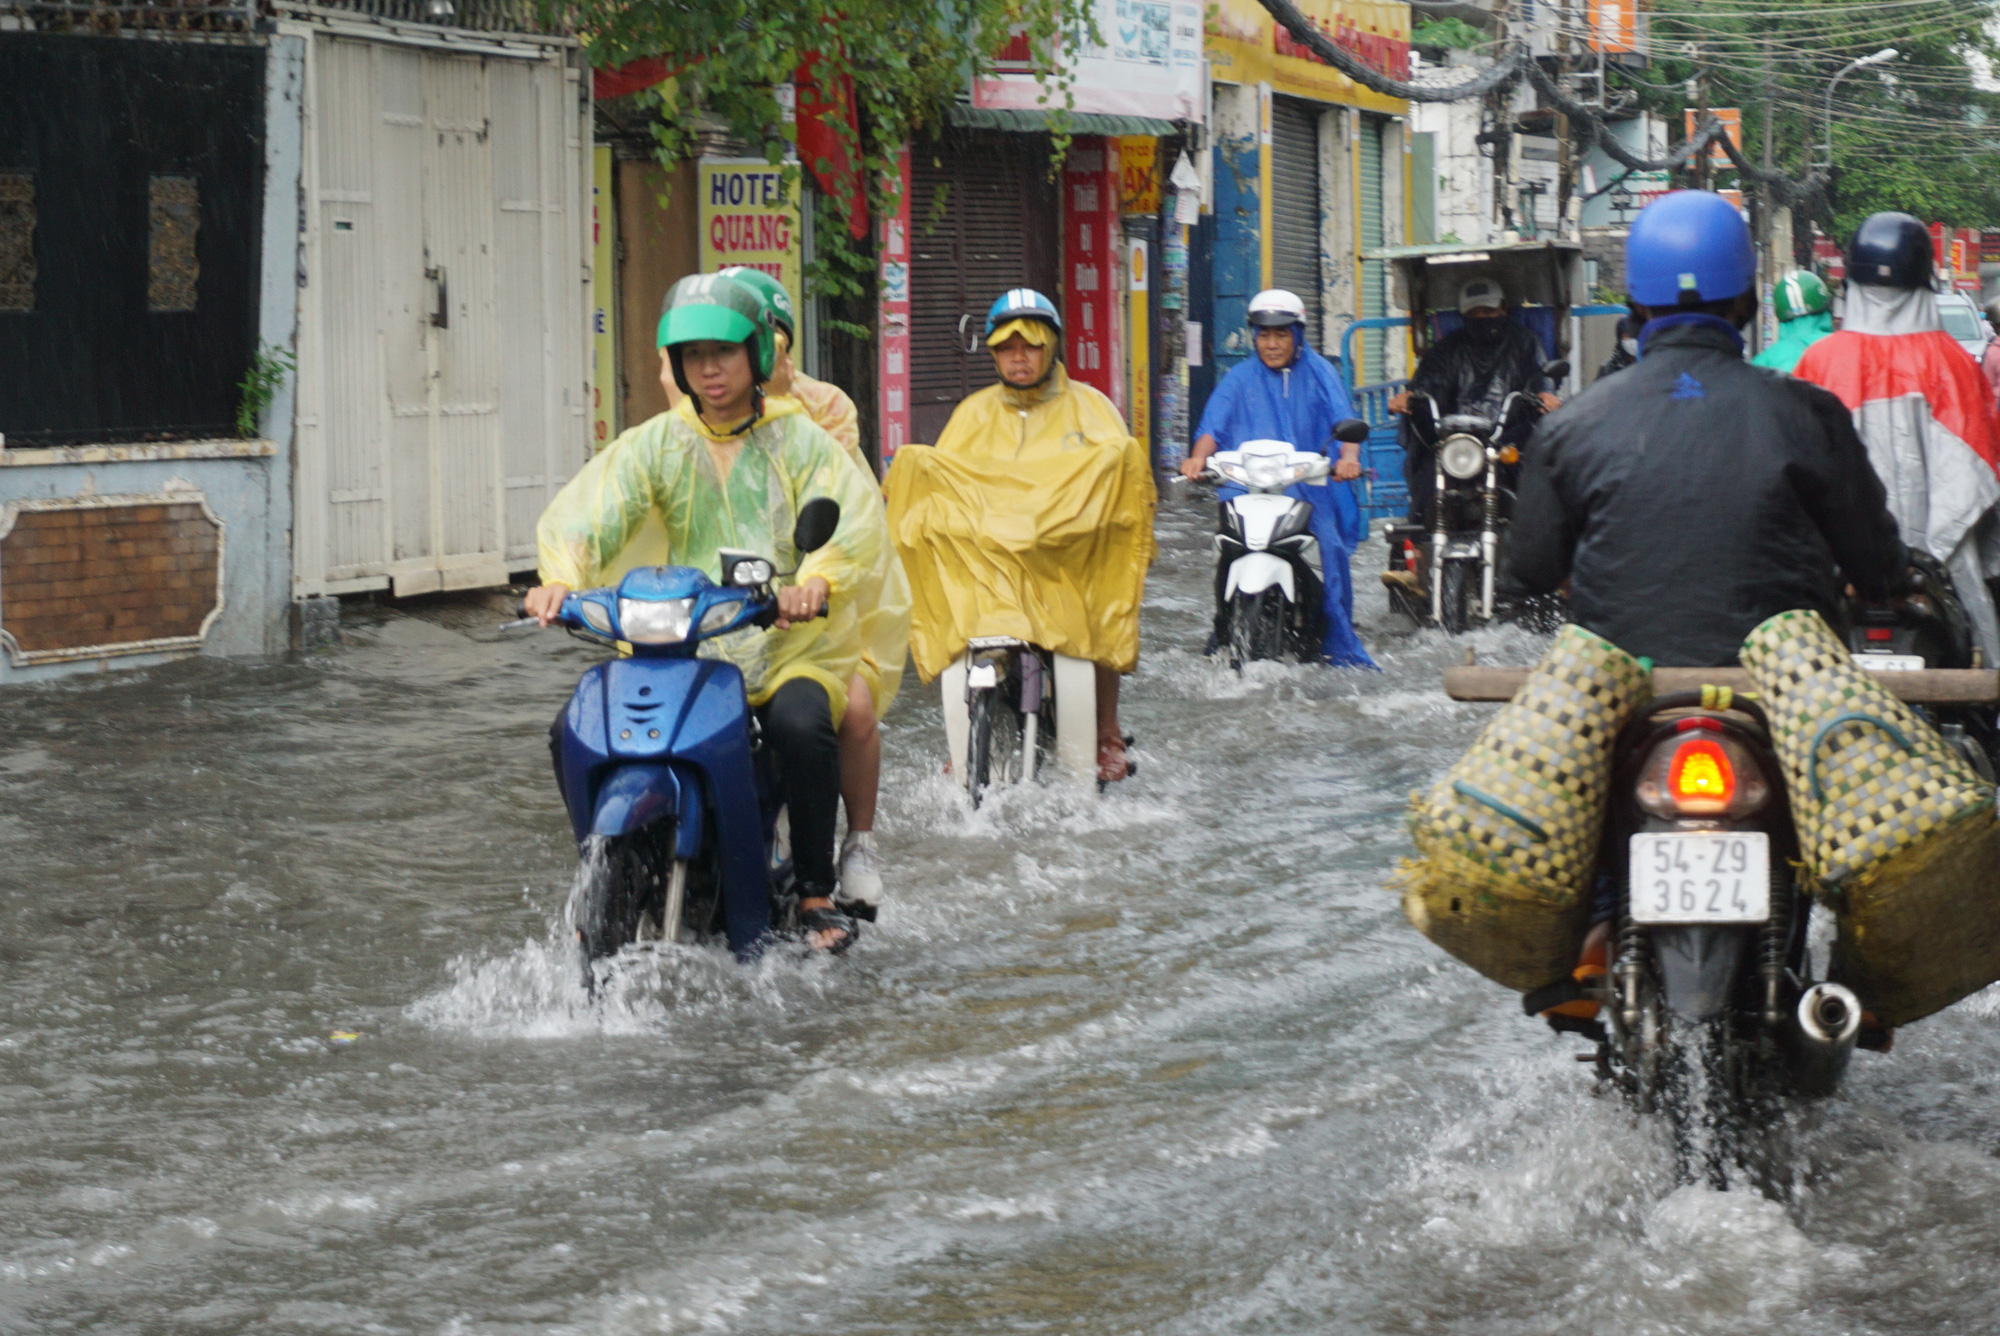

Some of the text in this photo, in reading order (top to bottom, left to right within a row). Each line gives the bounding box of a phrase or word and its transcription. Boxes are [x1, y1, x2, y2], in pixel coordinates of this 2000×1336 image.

[710, 214, 789, 254] QUANG
[1654, 840, 1747, 873] 54-Z9
[1654, 879, 1747, 912] 3624
